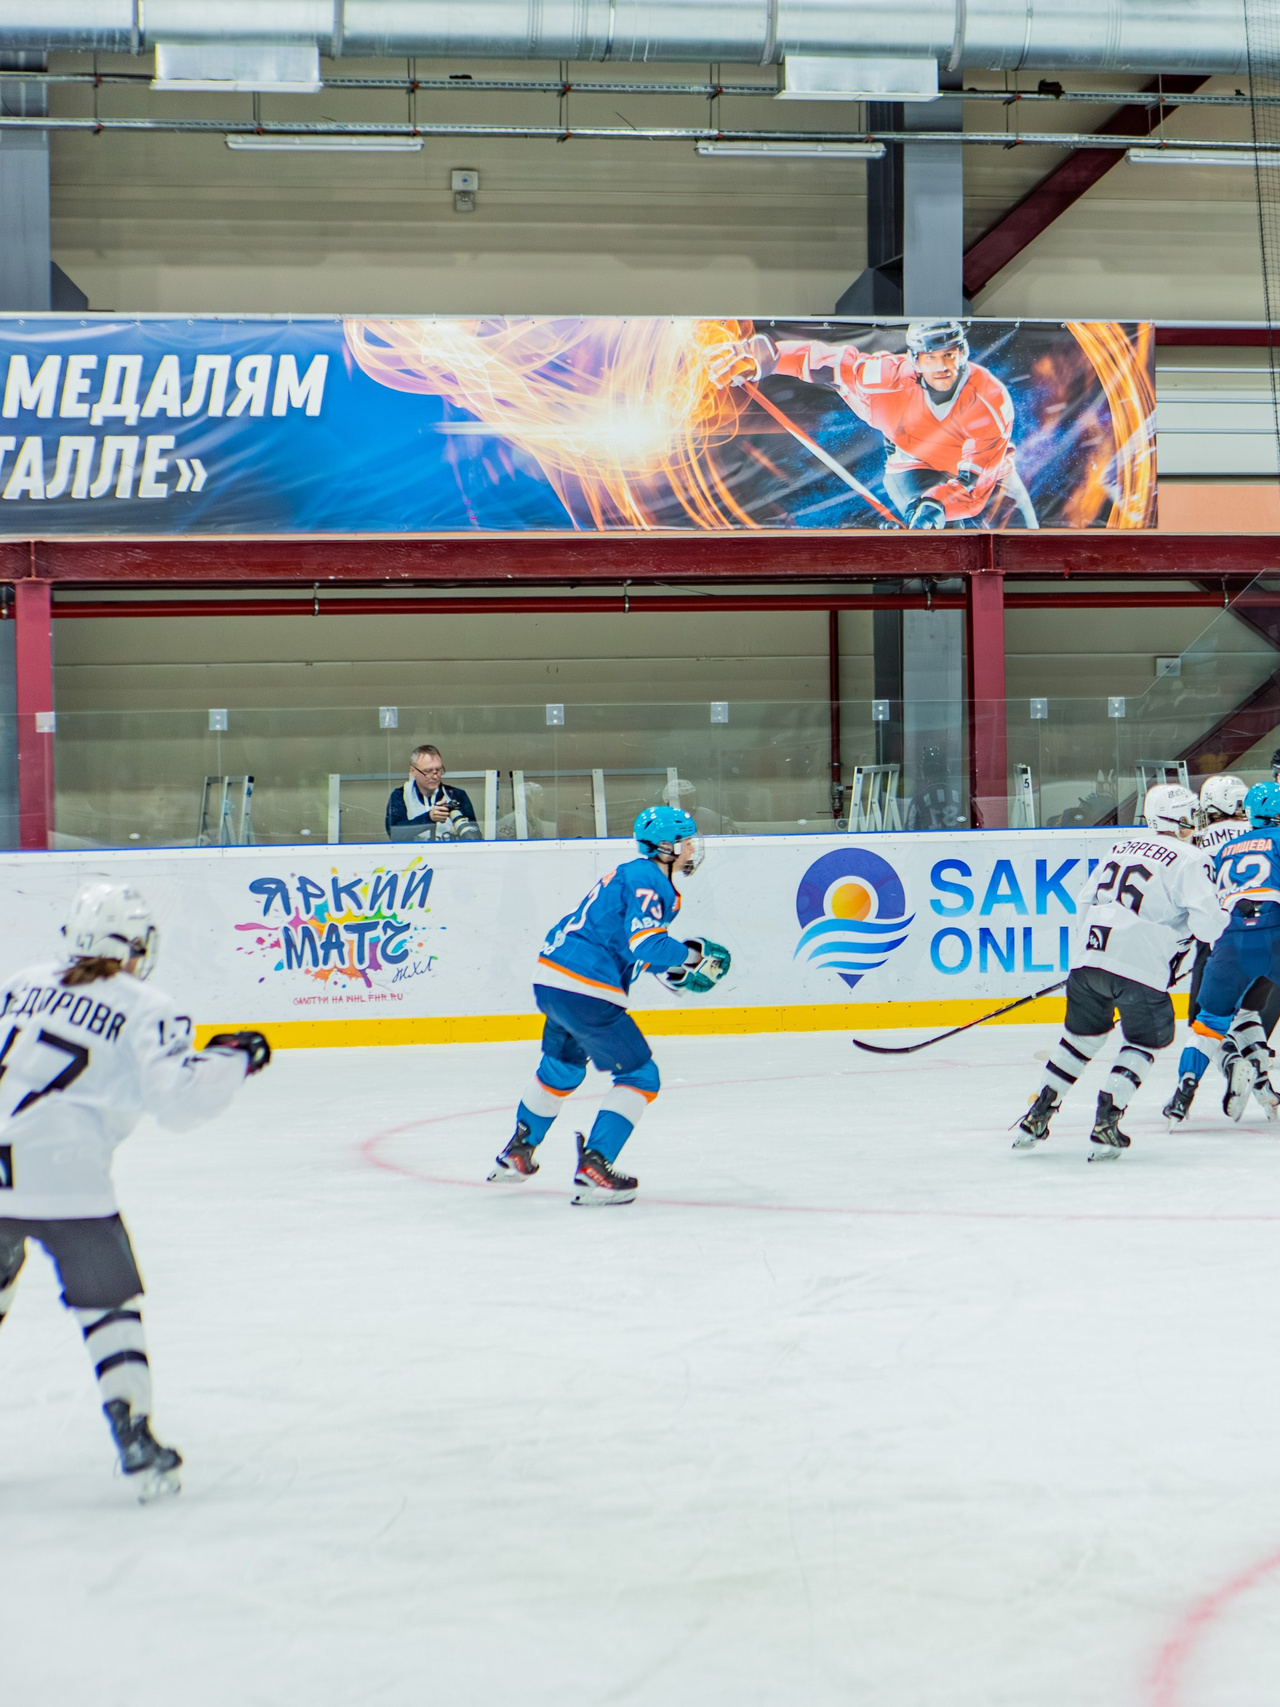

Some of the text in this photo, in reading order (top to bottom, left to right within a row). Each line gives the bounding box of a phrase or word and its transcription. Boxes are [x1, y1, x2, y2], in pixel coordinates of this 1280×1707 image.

[2, 354, 329, 426] МЕДАЛЯМ
[1024, 778, 1030, 788] 5
[248, 864, 434, 917] ЯРКИЙ
[929, 858, 1100, 918] SAK
[1092, 860, 1153, 916] 26
[929, 926, 1069, 976] ONLI
[293, 996, 329, 1006] СМОТРИ
[332, 994, 343, 1004] НА
